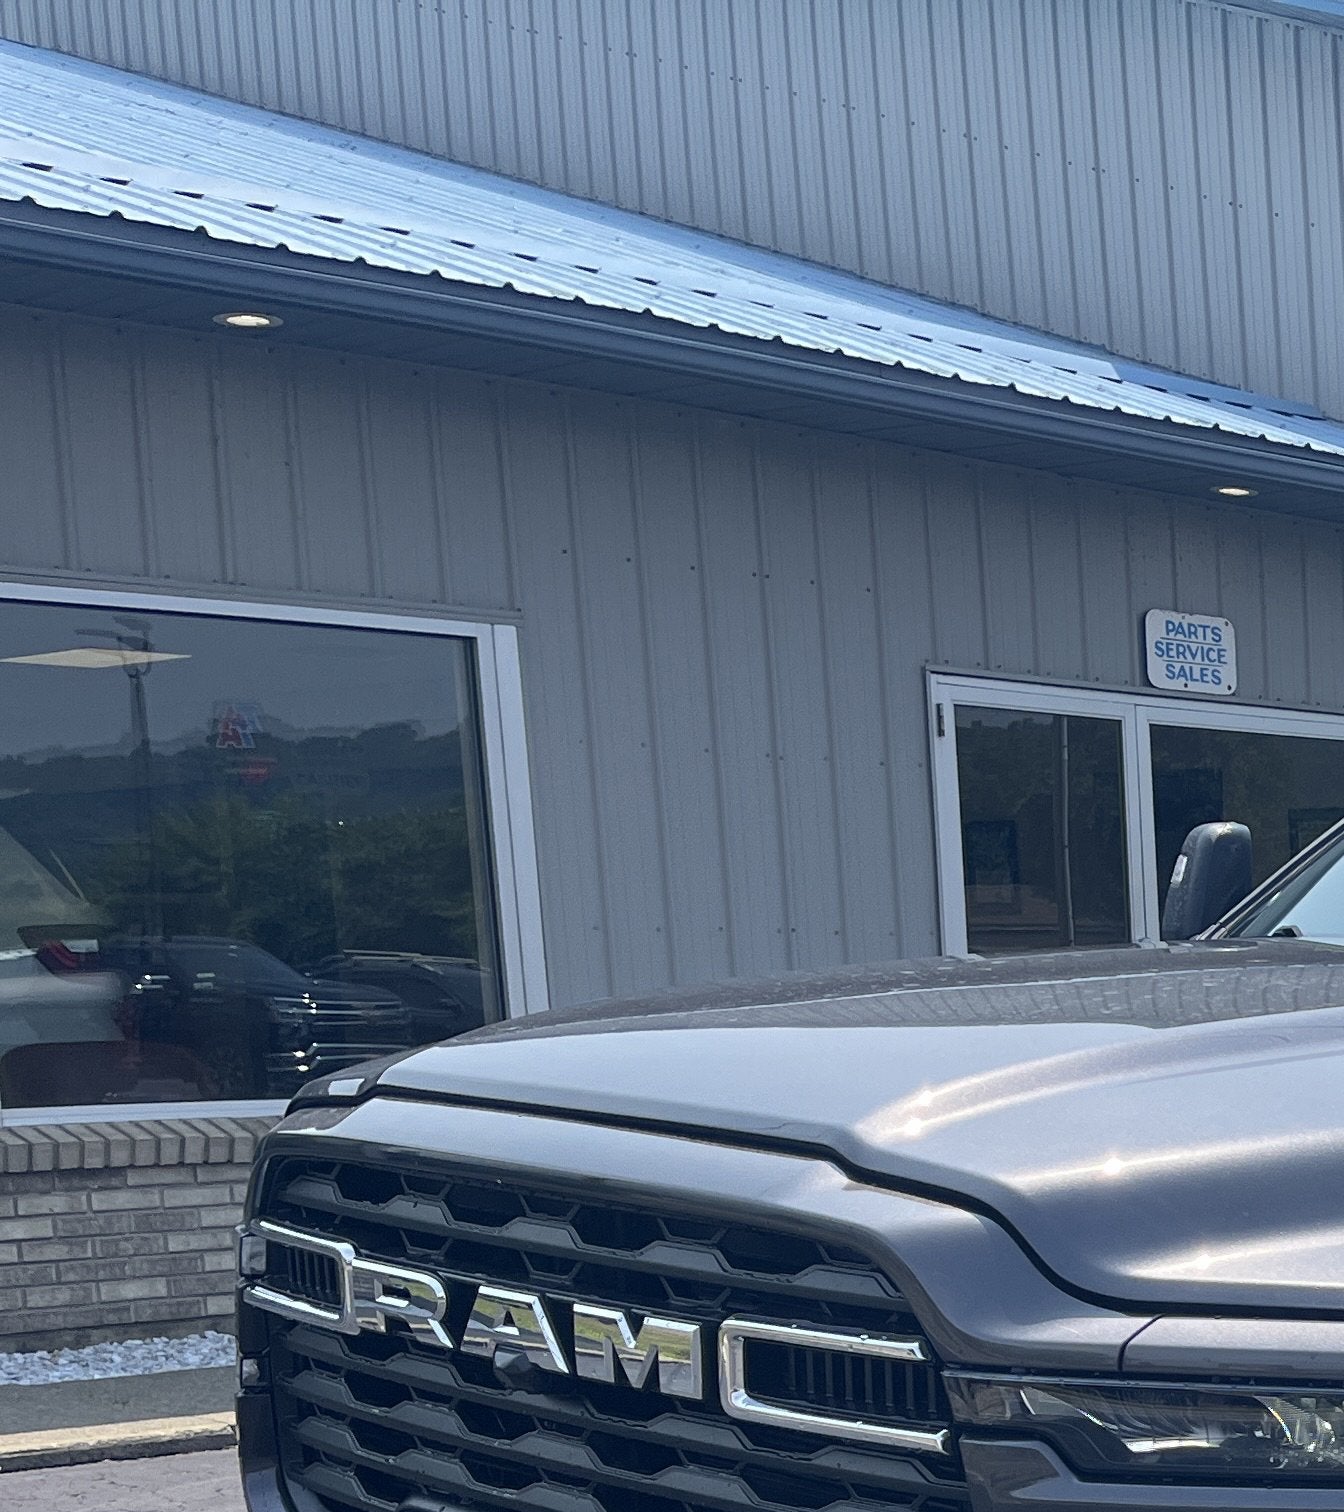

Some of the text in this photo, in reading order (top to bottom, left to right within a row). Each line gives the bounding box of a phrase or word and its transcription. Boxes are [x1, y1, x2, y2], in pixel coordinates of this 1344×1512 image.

[1165, 620, 1221, 642] PARTS
[1155, 642, 1227, 664] SERVICE
[1165, 664, 1221, 685] SALES
[349, 1256, 703, 1400] RAM
